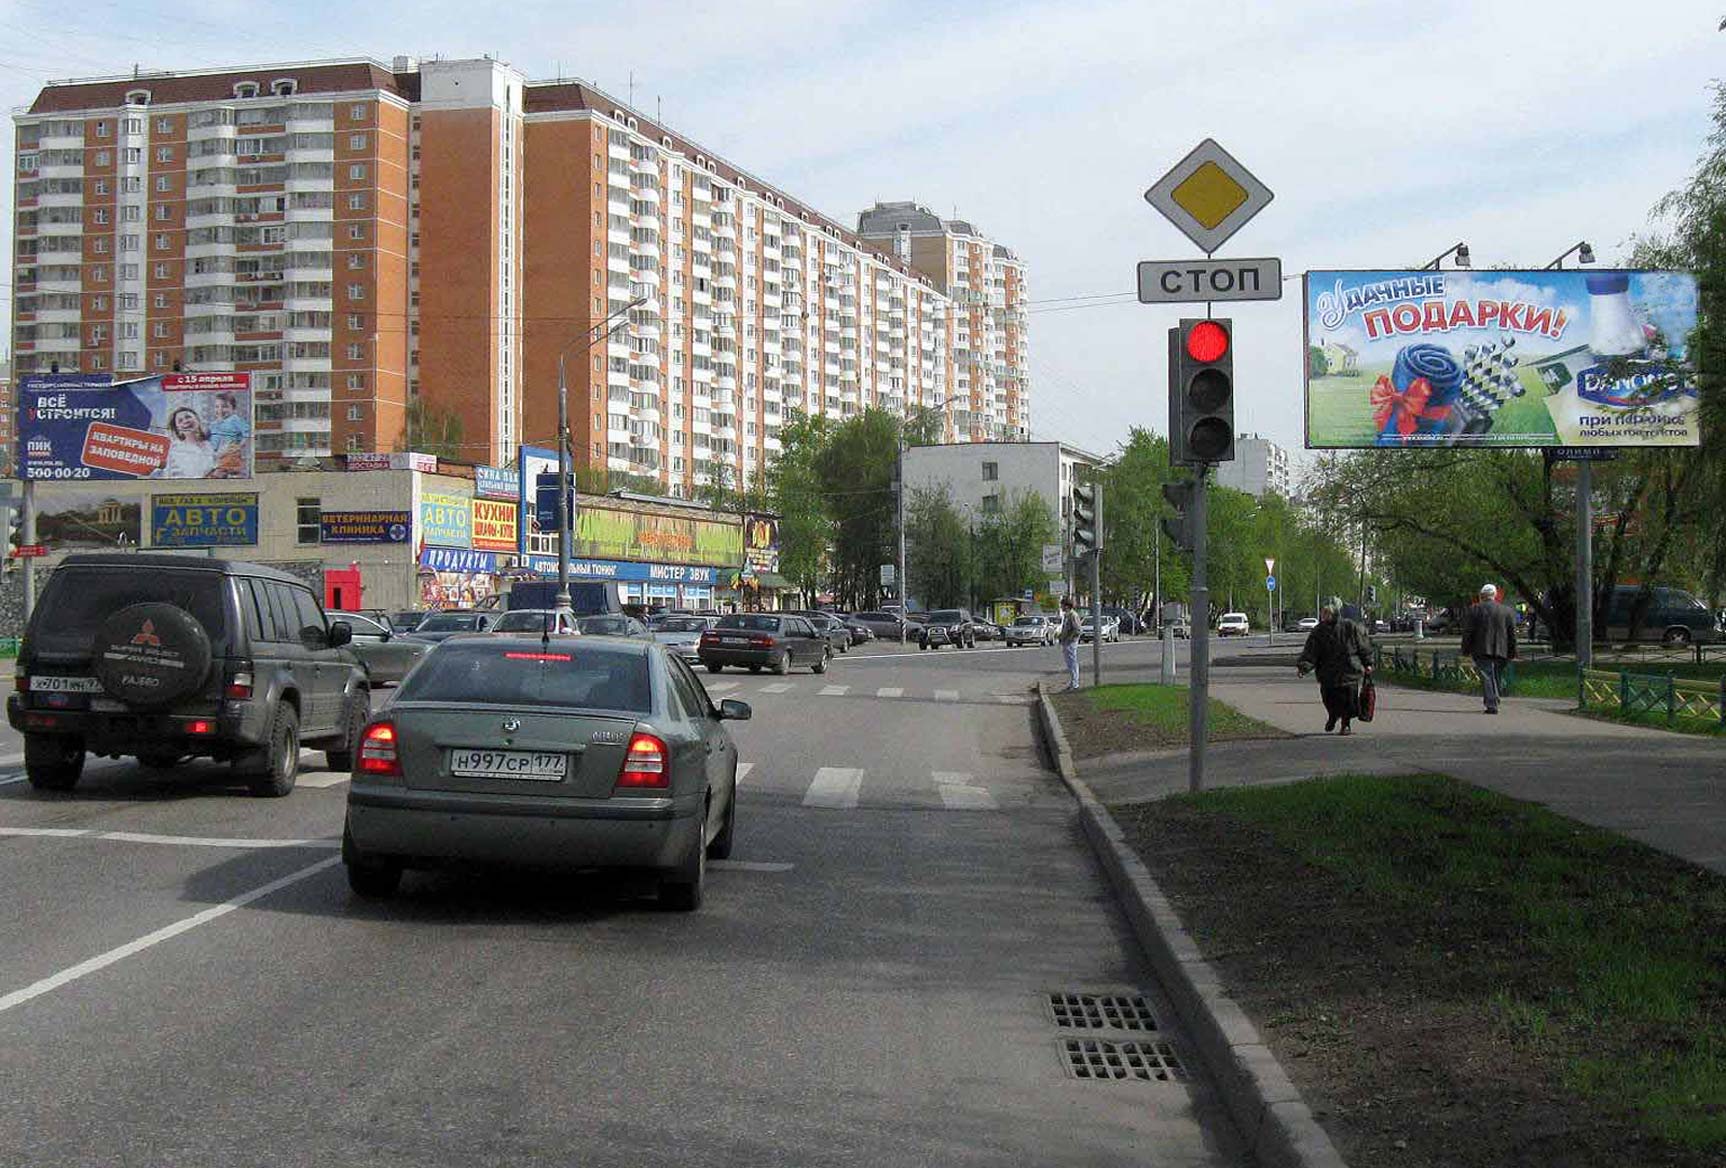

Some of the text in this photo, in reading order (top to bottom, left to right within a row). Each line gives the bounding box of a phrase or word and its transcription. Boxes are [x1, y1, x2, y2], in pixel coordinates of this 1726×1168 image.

[1160, 267, 1260, 294] СТОП
[1363, 299, 1568, 339] ПОДАРКИ!
[185, 375, 198, 383] 15
[37, 393, 67, 408] ВСЁ
[1579, 415, 1611, 427] при
[27, 441, 52, 451] ПИК
[92, 431, 148, 450] КВАРТИРЫ
[88, 445, 161, 466] ЗАПОВЕДНОЙ
[164, 507, 247, 526] АВТО
[322, 513, 408, 523] ВЕТЕРИНАРНАЯ
[424, 507, 466, 527] АВТО
[474, 501, 515, 523] КУХНИ
[331, 525, 385, 535] КЛИНИКА
[428, 548, 488, 571] ПРОДУКТЫ
[650, 565, 710, 582] МИСТЕР ЗВУК
[534, 755, 562, 769] 177
